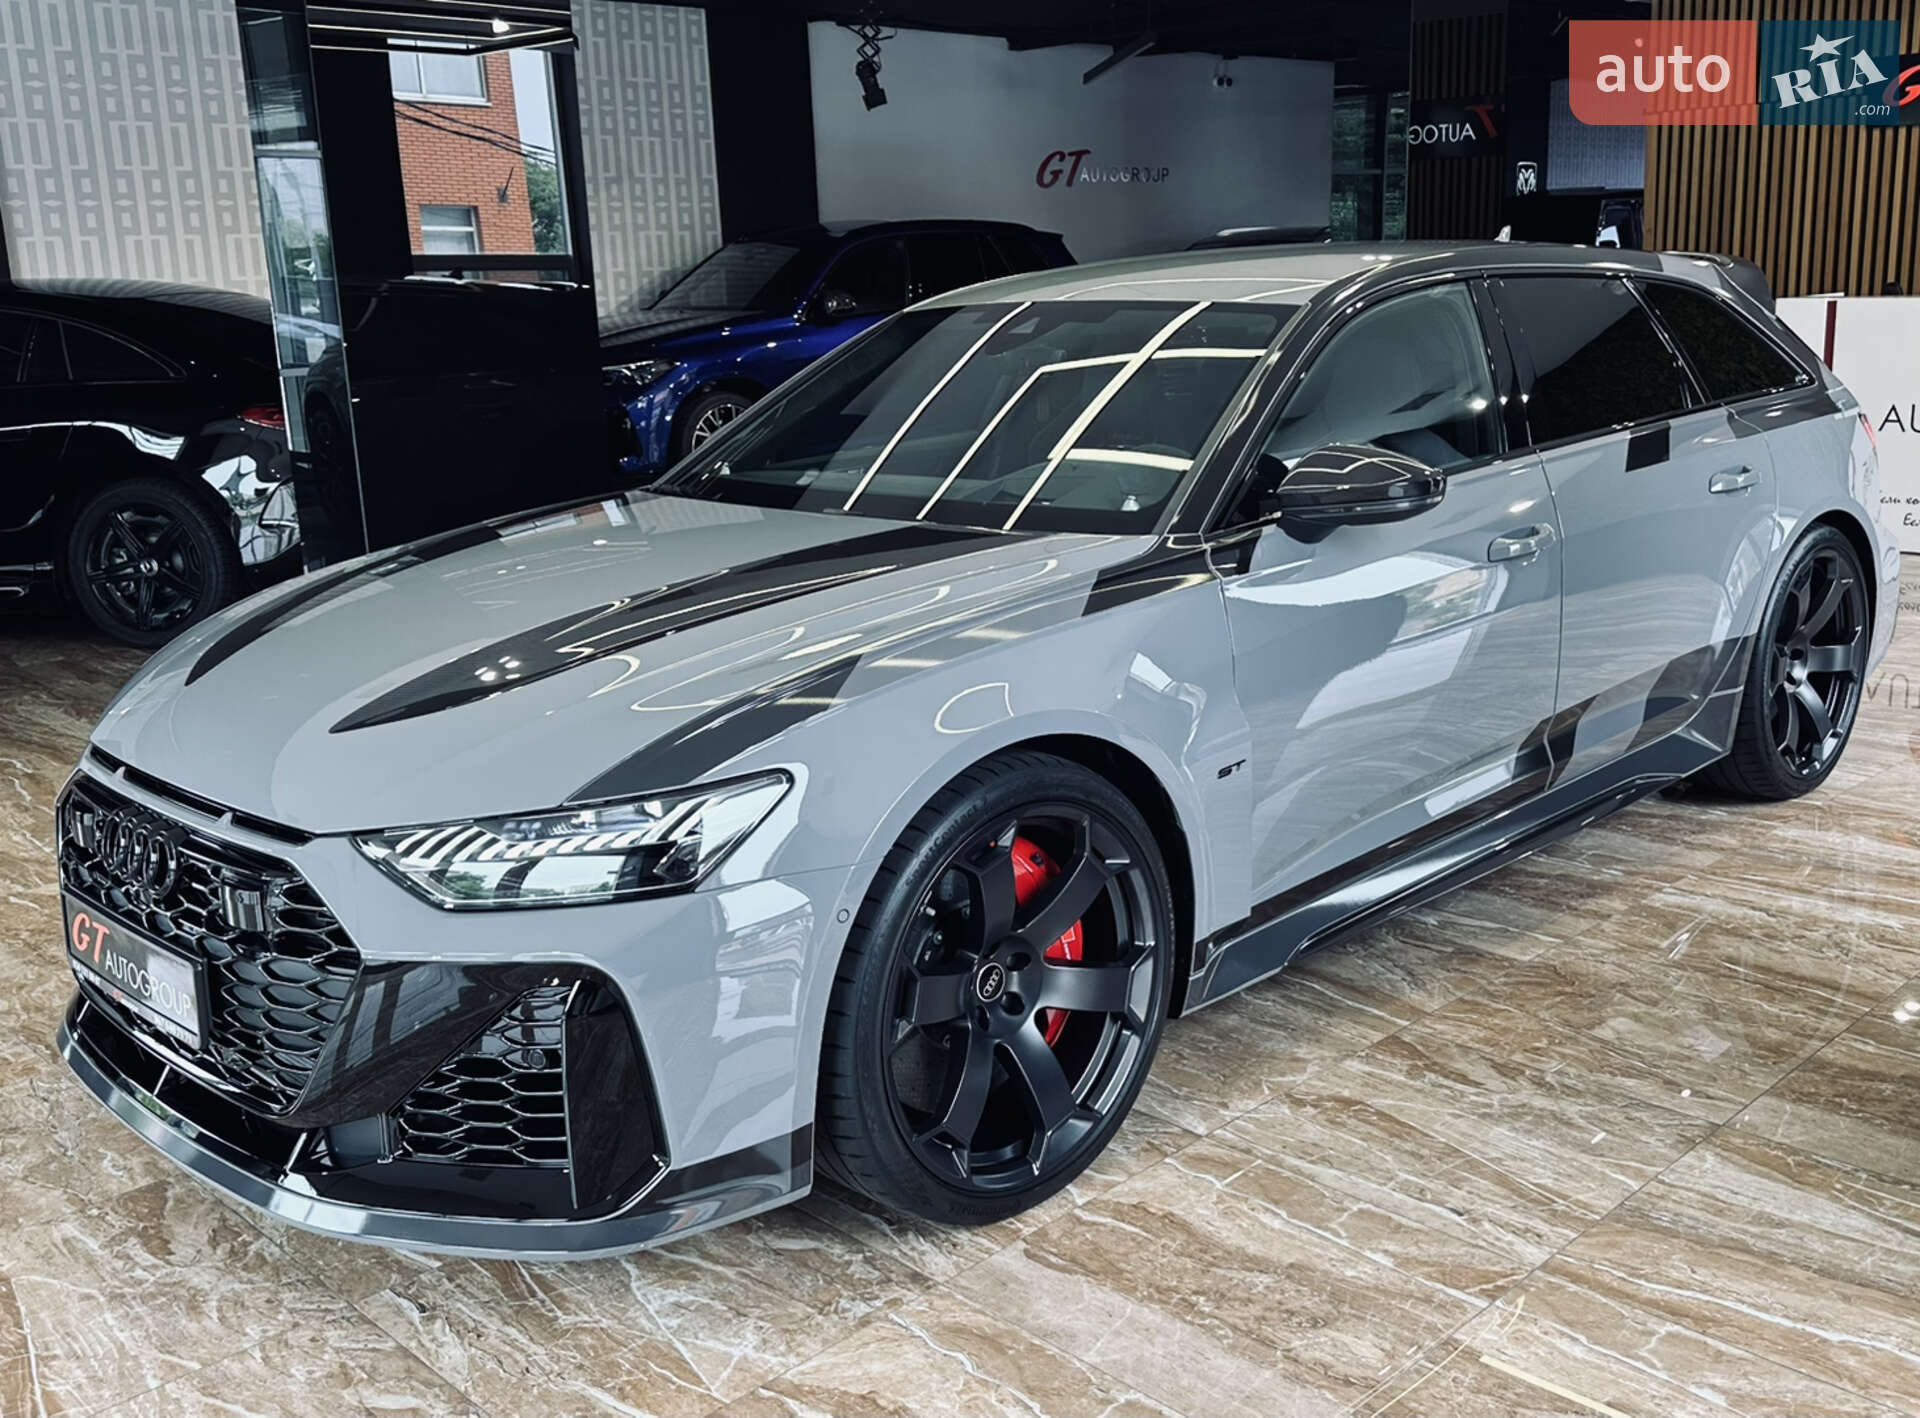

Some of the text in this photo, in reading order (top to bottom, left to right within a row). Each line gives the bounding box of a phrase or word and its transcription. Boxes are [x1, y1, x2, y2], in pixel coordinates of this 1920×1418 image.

[1036, 149, 1091, 189] GT
[72, 912, 110, 963] GT
[105, 949, 191, 1017] AUTOGROUP
